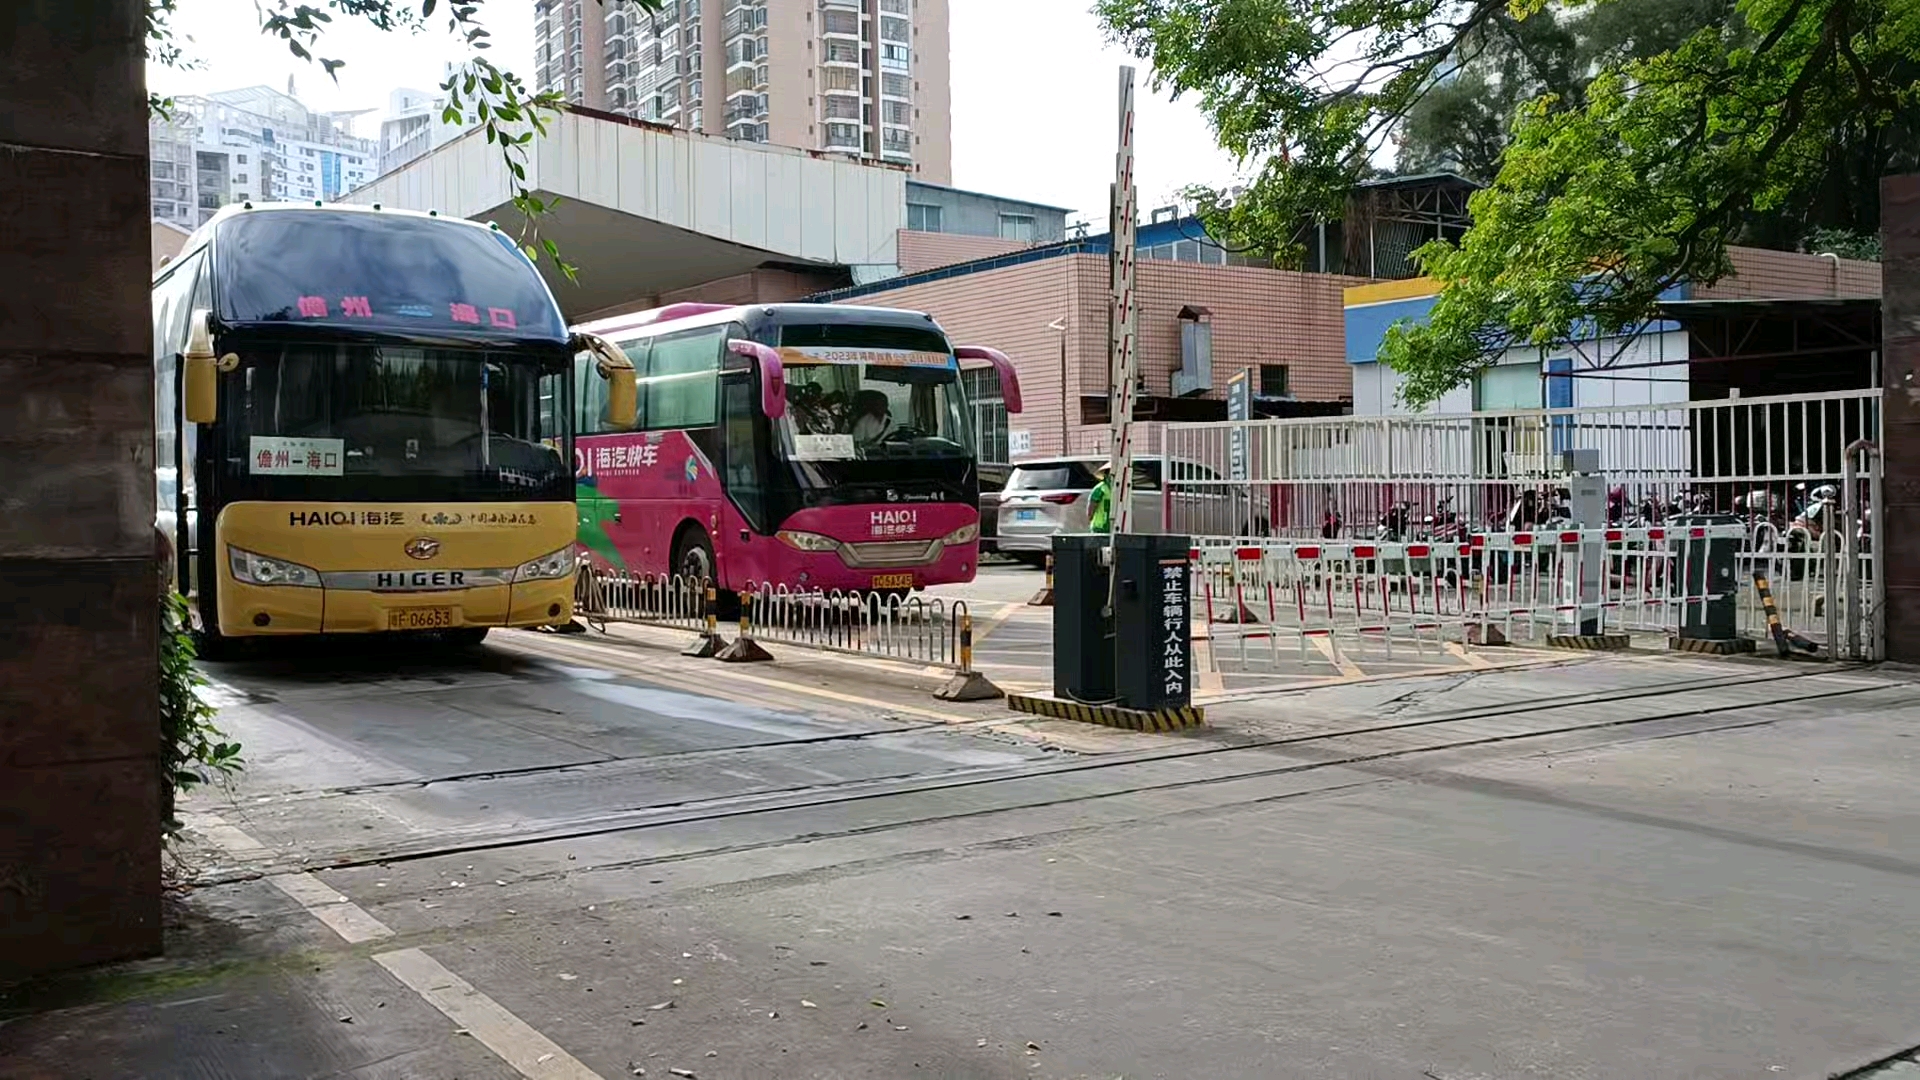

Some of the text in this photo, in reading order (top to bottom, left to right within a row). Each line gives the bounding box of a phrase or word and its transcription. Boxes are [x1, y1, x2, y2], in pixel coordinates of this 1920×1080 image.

[596, 444, 660, 469] 海汽快车
[290, 511, 405, 526] HAIQI 海汽
[377, 571, 465, 588] HIGER
[1162, 566, 1185, 695] 禁止车辆行人从此入内
